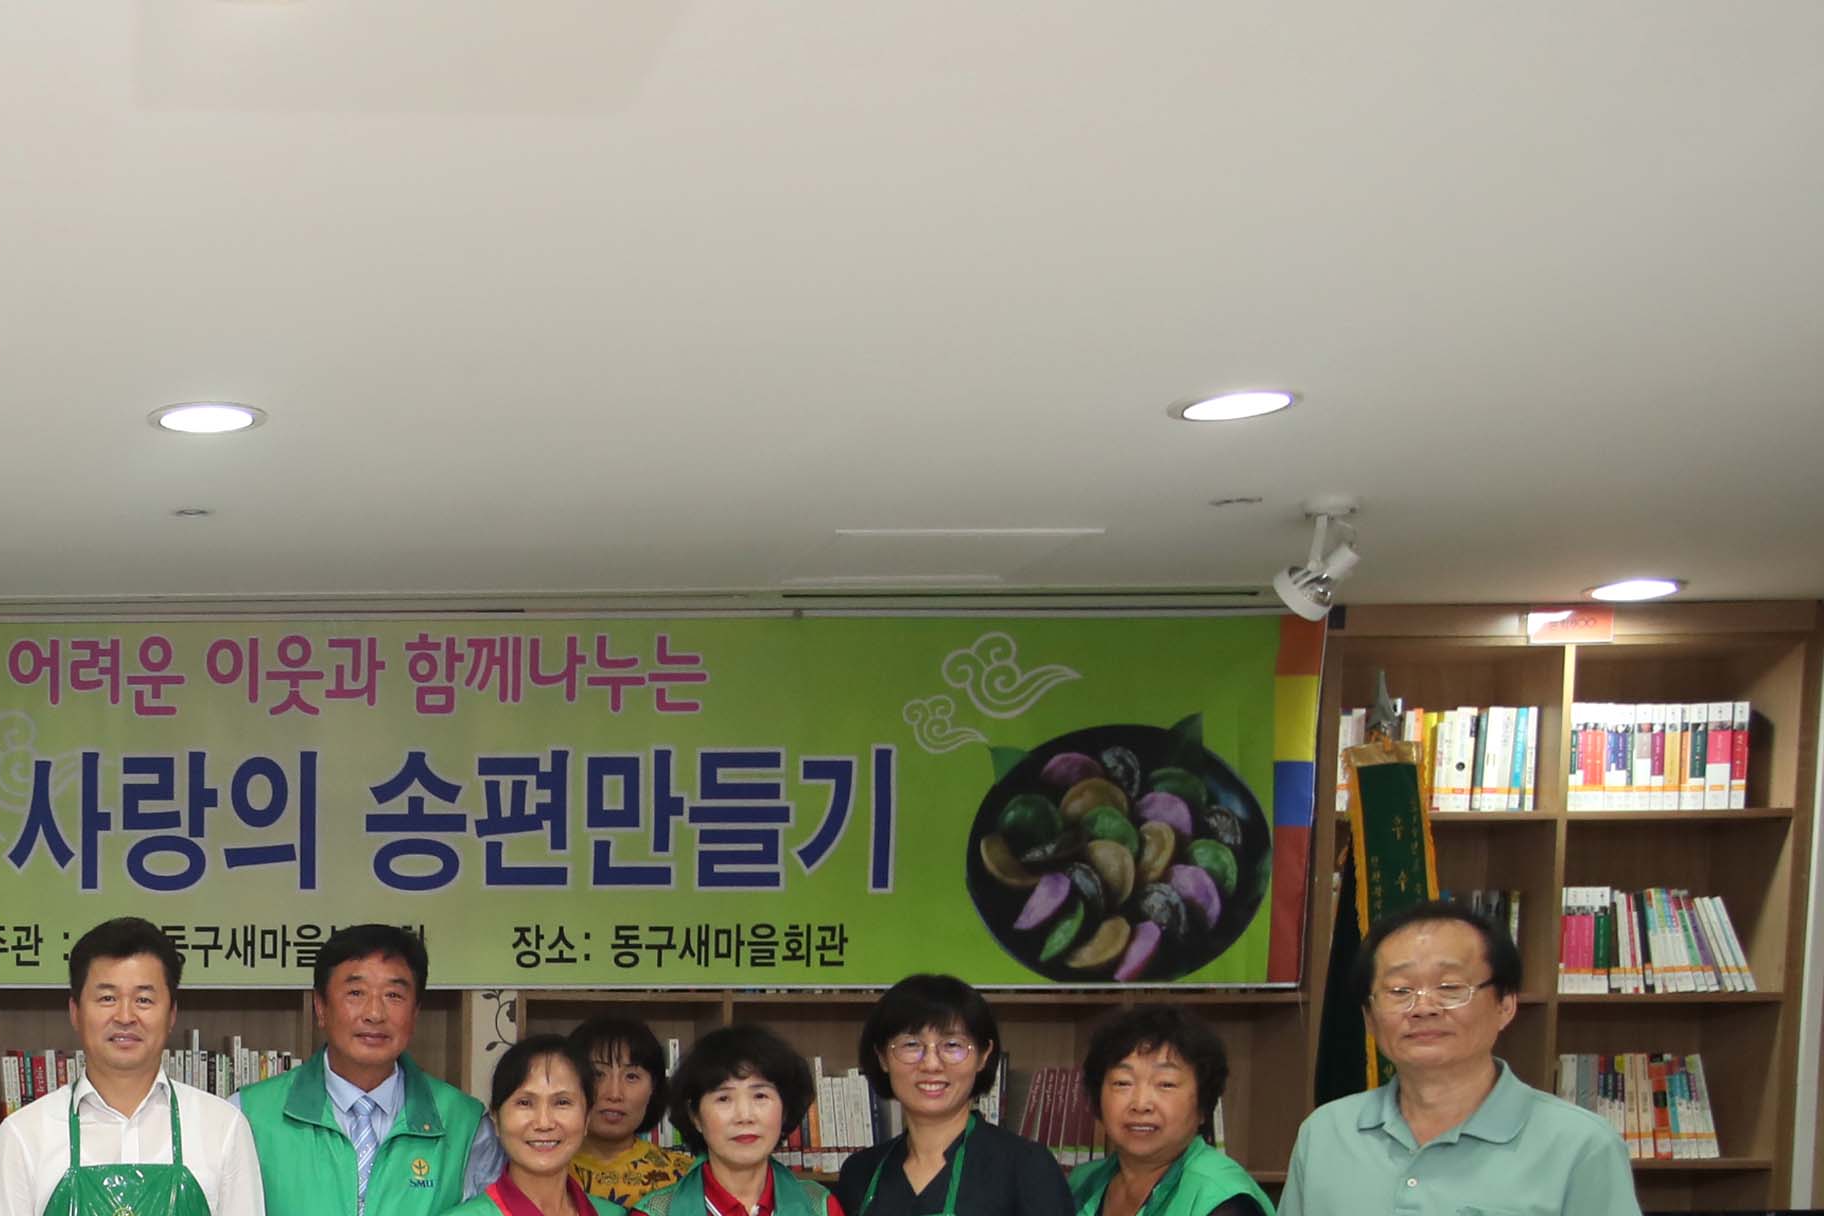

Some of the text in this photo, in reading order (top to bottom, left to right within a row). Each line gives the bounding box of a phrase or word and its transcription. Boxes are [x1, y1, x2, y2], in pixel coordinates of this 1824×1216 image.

[8, 636, 185, 716] 어려운
[206, 634, 385, 716] 이웃과
[405, 632, 708, 715] 함께나누는
[8, 748, 318, 891] 사랑의
[365, 747, 894, 891] 송편만들기
[511, 922, 850, 968] 장소: 동구새마을회관
[409, 1178, 434, 1189] SMU
